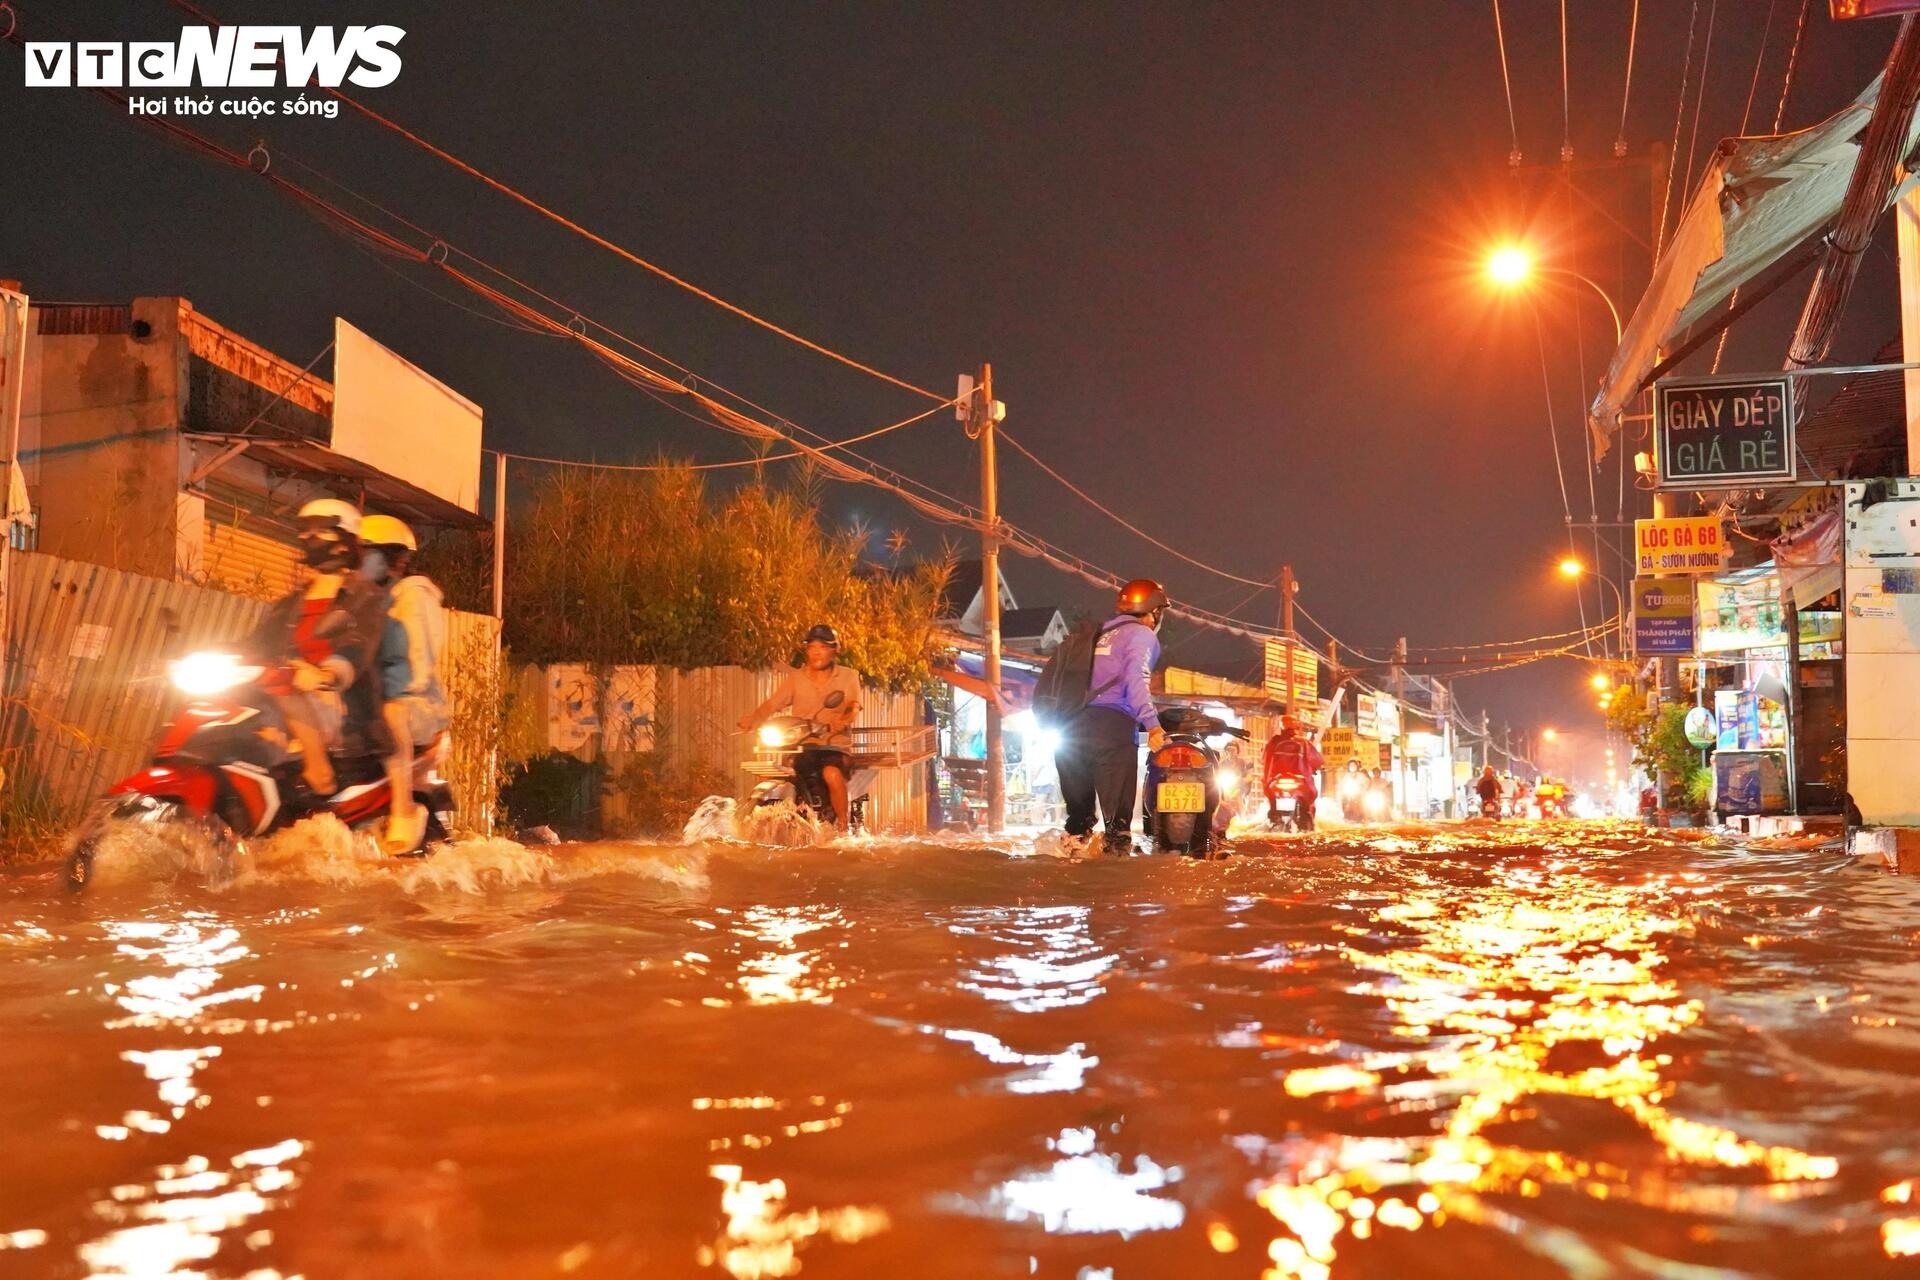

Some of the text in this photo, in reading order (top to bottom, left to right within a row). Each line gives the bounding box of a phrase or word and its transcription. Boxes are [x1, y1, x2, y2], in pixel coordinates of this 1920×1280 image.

[1670, 389, 1781, 430] GIÀY DÉP
[1677, 430, 1778, 472] GIÁ RẺ
[1698, 526, 1716, 546] 68
[1645, 594, 1691, 606] TUBORG
[1164, 798, 1198, 810] 0378
